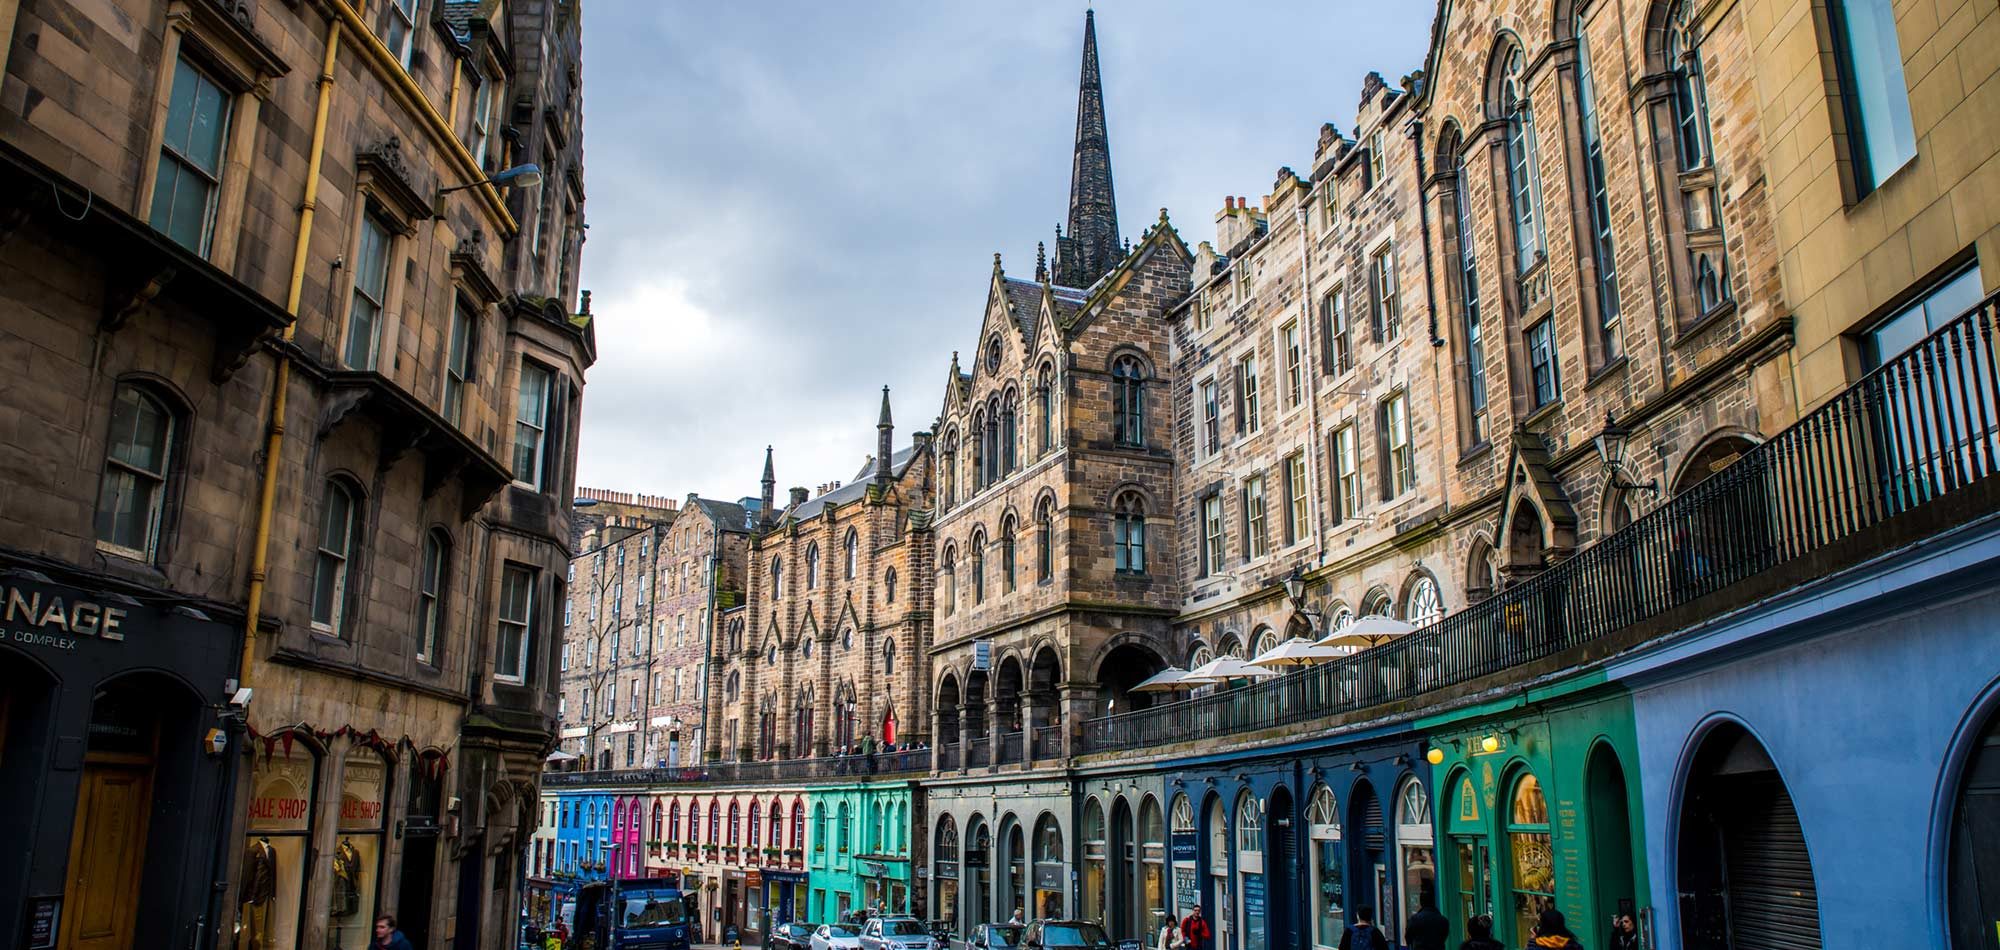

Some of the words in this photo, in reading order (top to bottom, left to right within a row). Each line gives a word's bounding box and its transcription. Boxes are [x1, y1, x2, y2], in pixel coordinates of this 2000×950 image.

[0, 585, 128, 641] NAGE
[14, 631, 76, 649] COMPLEX
[248, 797, 274, 818] SALE
[277, 798, 307, 819] SHOP
[341, 799, 357, 818] ALE
[360, 800, 381, 819] SHOP
